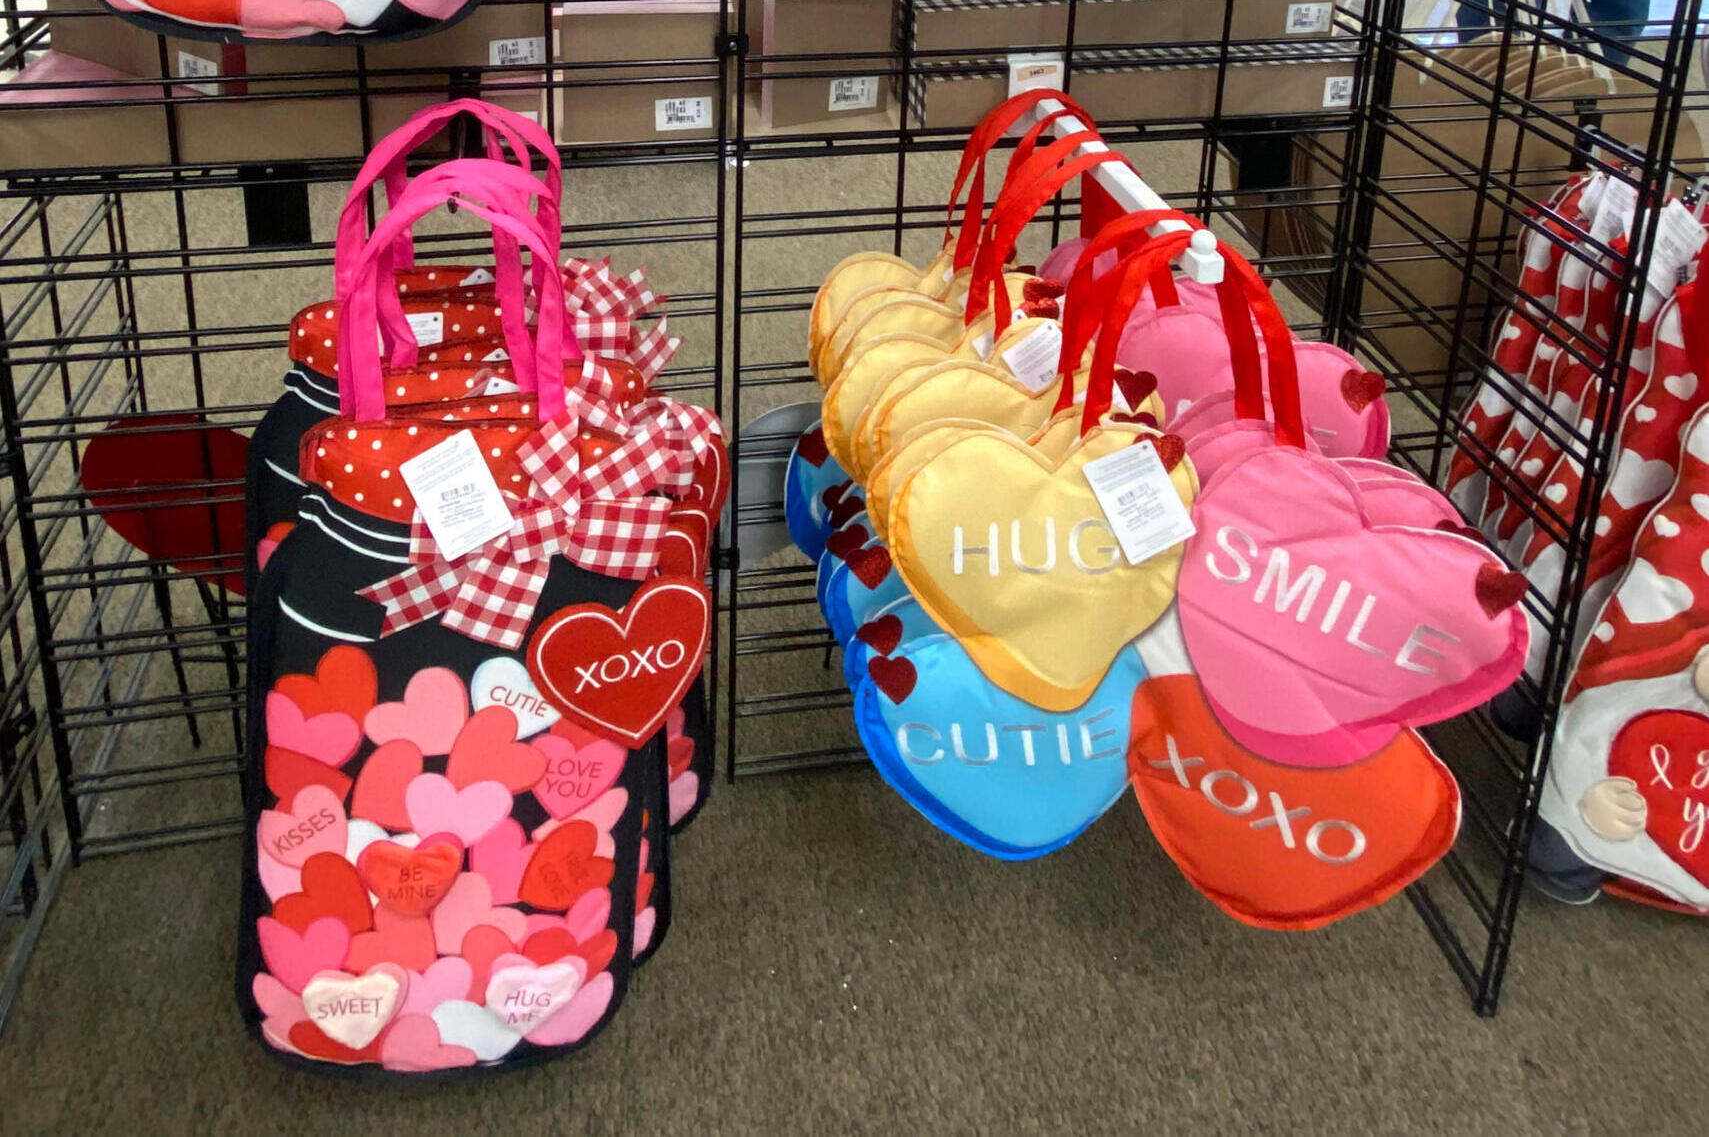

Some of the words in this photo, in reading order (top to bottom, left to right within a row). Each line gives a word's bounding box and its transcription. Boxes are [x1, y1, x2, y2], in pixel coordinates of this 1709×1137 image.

[949, 516, 1123, 576] HUG
[1204, 525, 1461, 675] SMILE
[574, 639, 685, 694] XOXO
[489, 685, 548, 719] CUTIE
[896, 707, 1123, 766] CUTIE
[545, 758, 604, 779] LOVE
[545, 780, 592, 799] YOU
[1147, 733, 1367, 864] XOXO
[272, 808, 337, 855] KISSES
[400, 865, 424, 883] BE
[387, 884, 438, 901] MINE
[316, 996, 385, 1021] SWEET
[504, 989, 552, 1008] HUG
